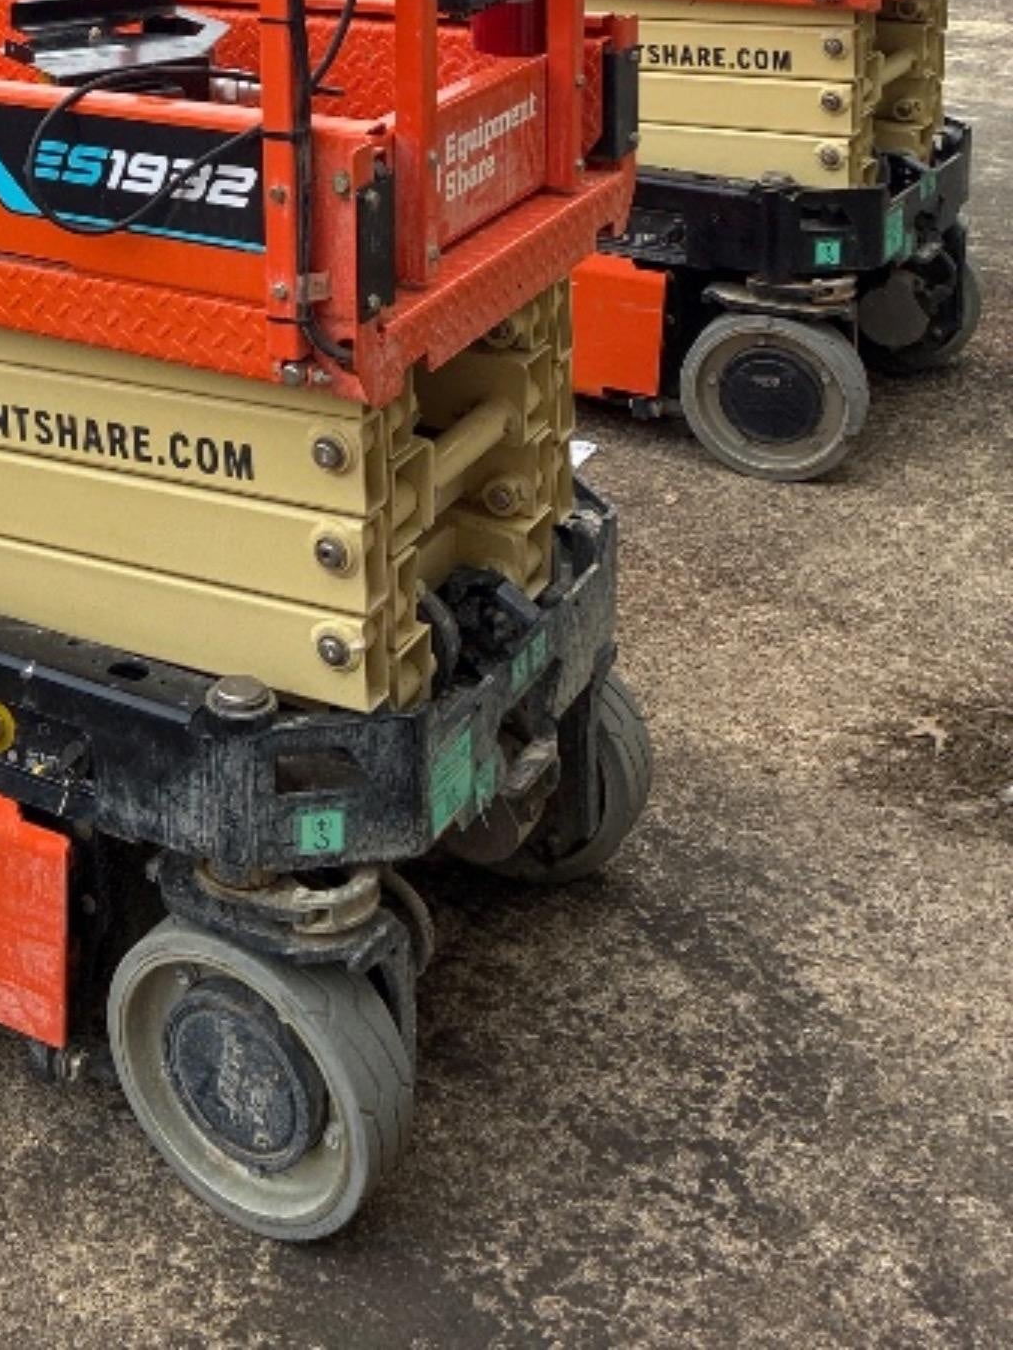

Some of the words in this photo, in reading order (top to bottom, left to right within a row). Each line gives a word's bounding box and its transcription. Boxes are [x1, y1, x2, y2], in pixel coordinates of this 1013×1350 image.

[445, 91, 537, 165] Equipment
[34, 139, 259, 208] ES1932
[444, 153, 496, 202] Share
